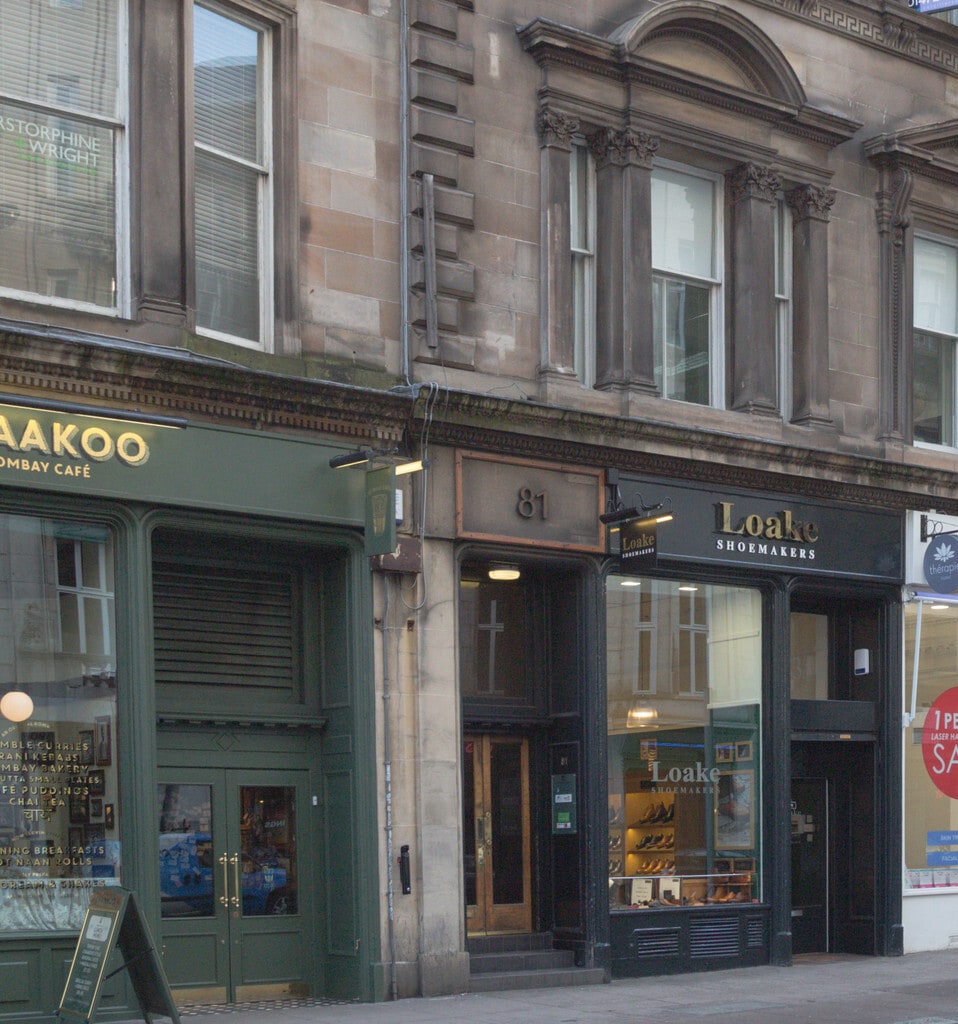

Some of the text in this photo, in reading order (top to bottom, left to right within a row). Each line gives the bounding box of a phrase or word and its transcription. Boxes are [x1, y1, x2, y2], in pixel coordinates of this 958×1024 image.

[28, 139, 98, 167] WRIGHT
[54, 463, 91, 478] CAFÉ
[517, 487, 548, 519] 81
[719, 501, 819, 544] Loake
[622, 533, 655, 551] Loake
[717, 539, 816, 560] SHOEMAKERS
[935, 710, 941, 731] 1
[931, 732, 949, 741] LASER
[651, 761, 721, 783] Loake
[650, 785, 721, 794] SHOEMAKERS
[9, 797, 66, 808] CHAI TEA
